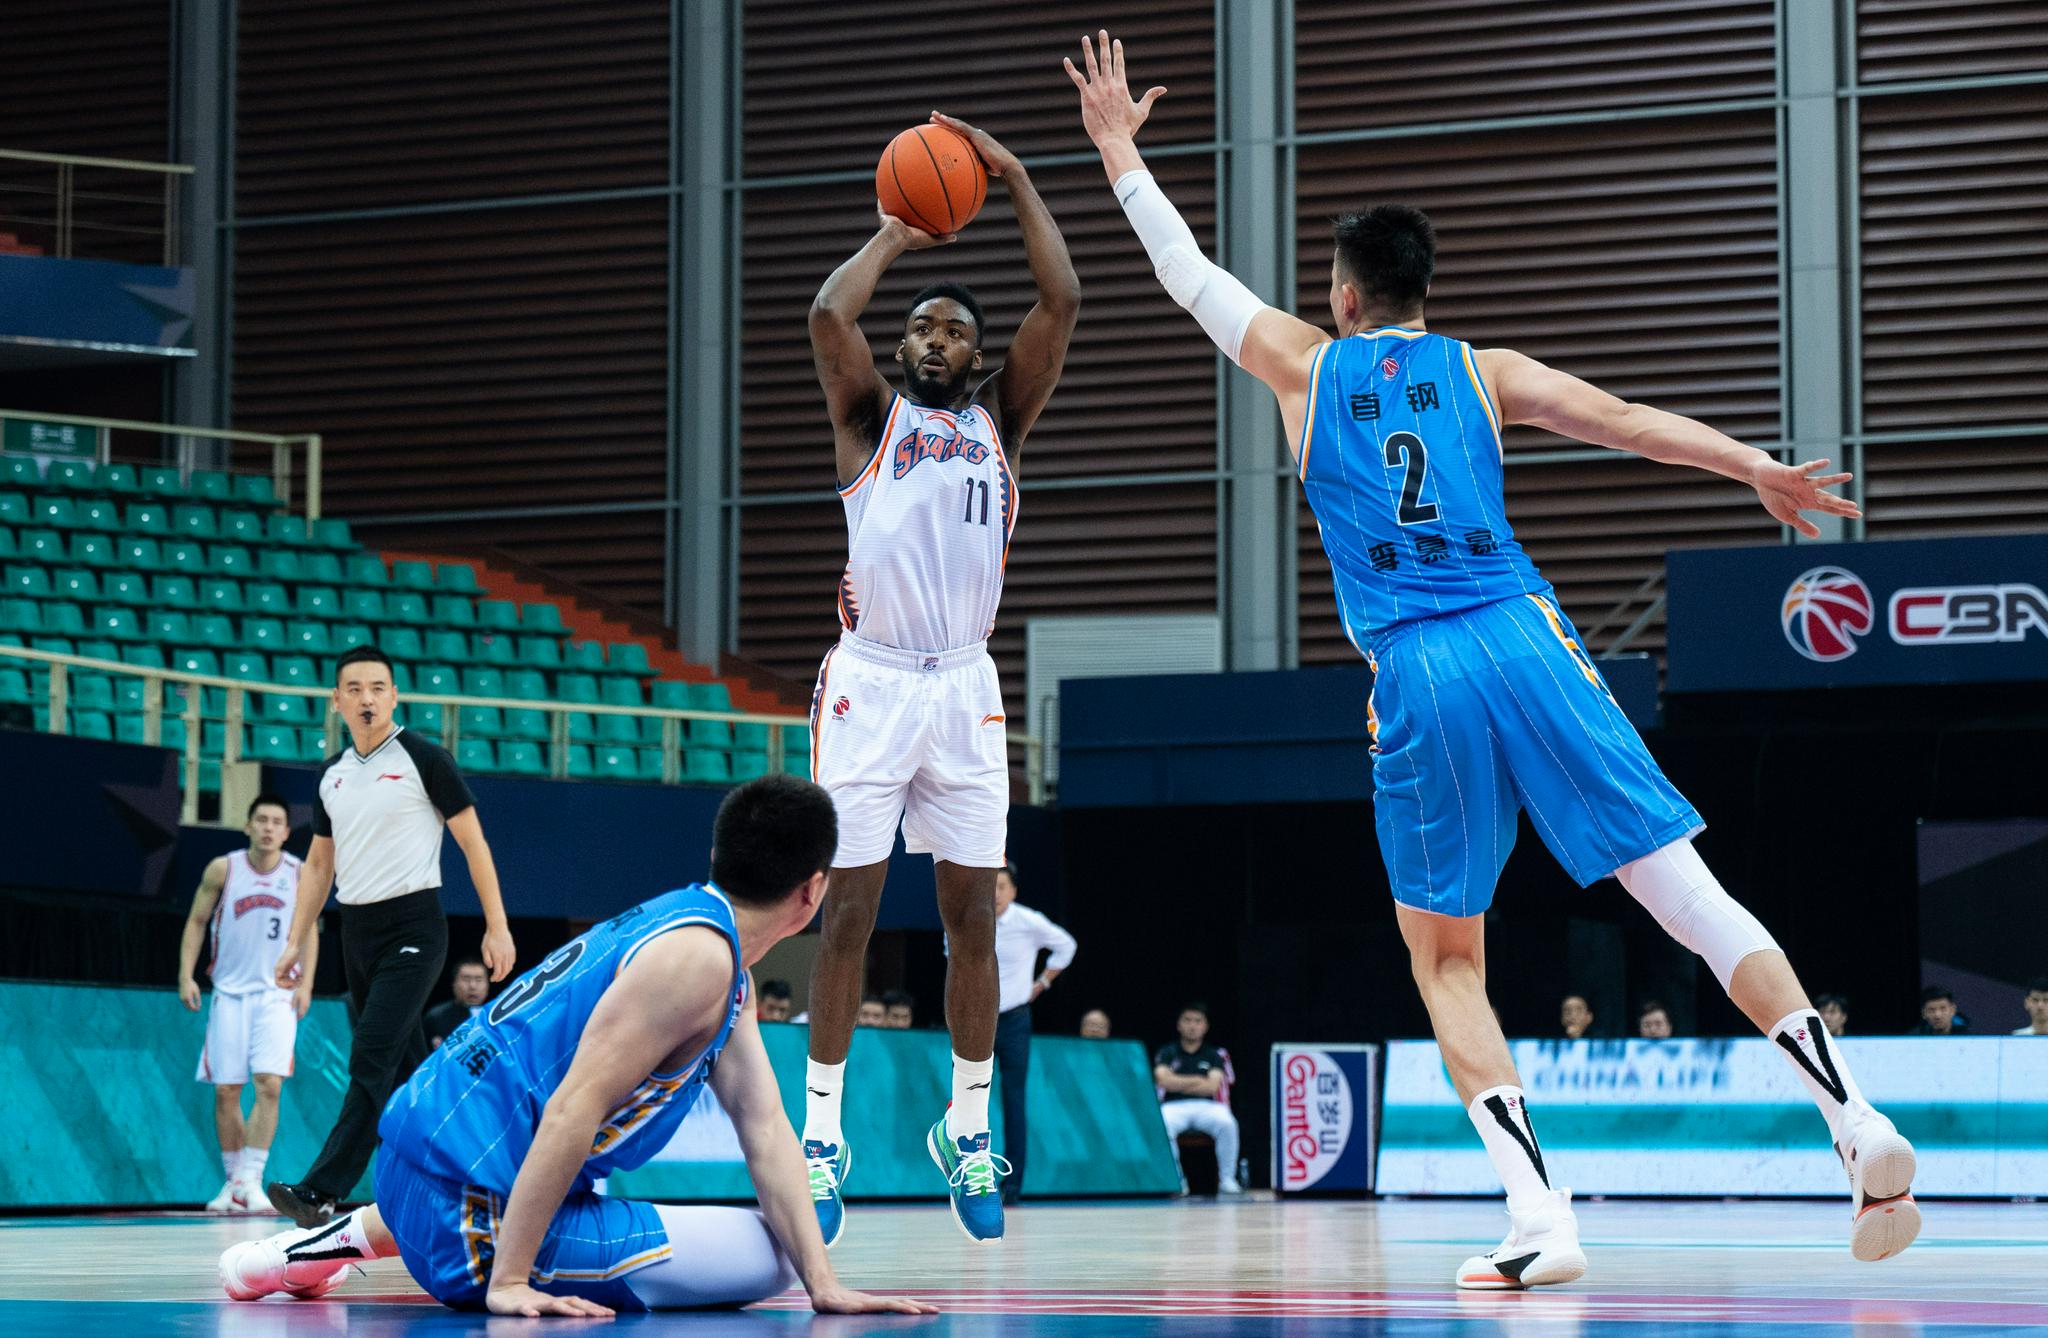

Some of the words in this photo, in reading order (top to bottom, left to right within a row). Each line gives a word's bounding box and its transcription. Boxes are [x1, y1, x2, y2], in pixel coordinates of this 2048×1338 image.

[1349, 381, 1441, 422] 首钢
[964, 477, 989, 526] 11
[1383, 431, 1441, 526] 2
[1890, 584, 2048, 645] CBA
[266, 916, 281, 940] 3
[1317, 1072, 1339, 1154] 百岁山
